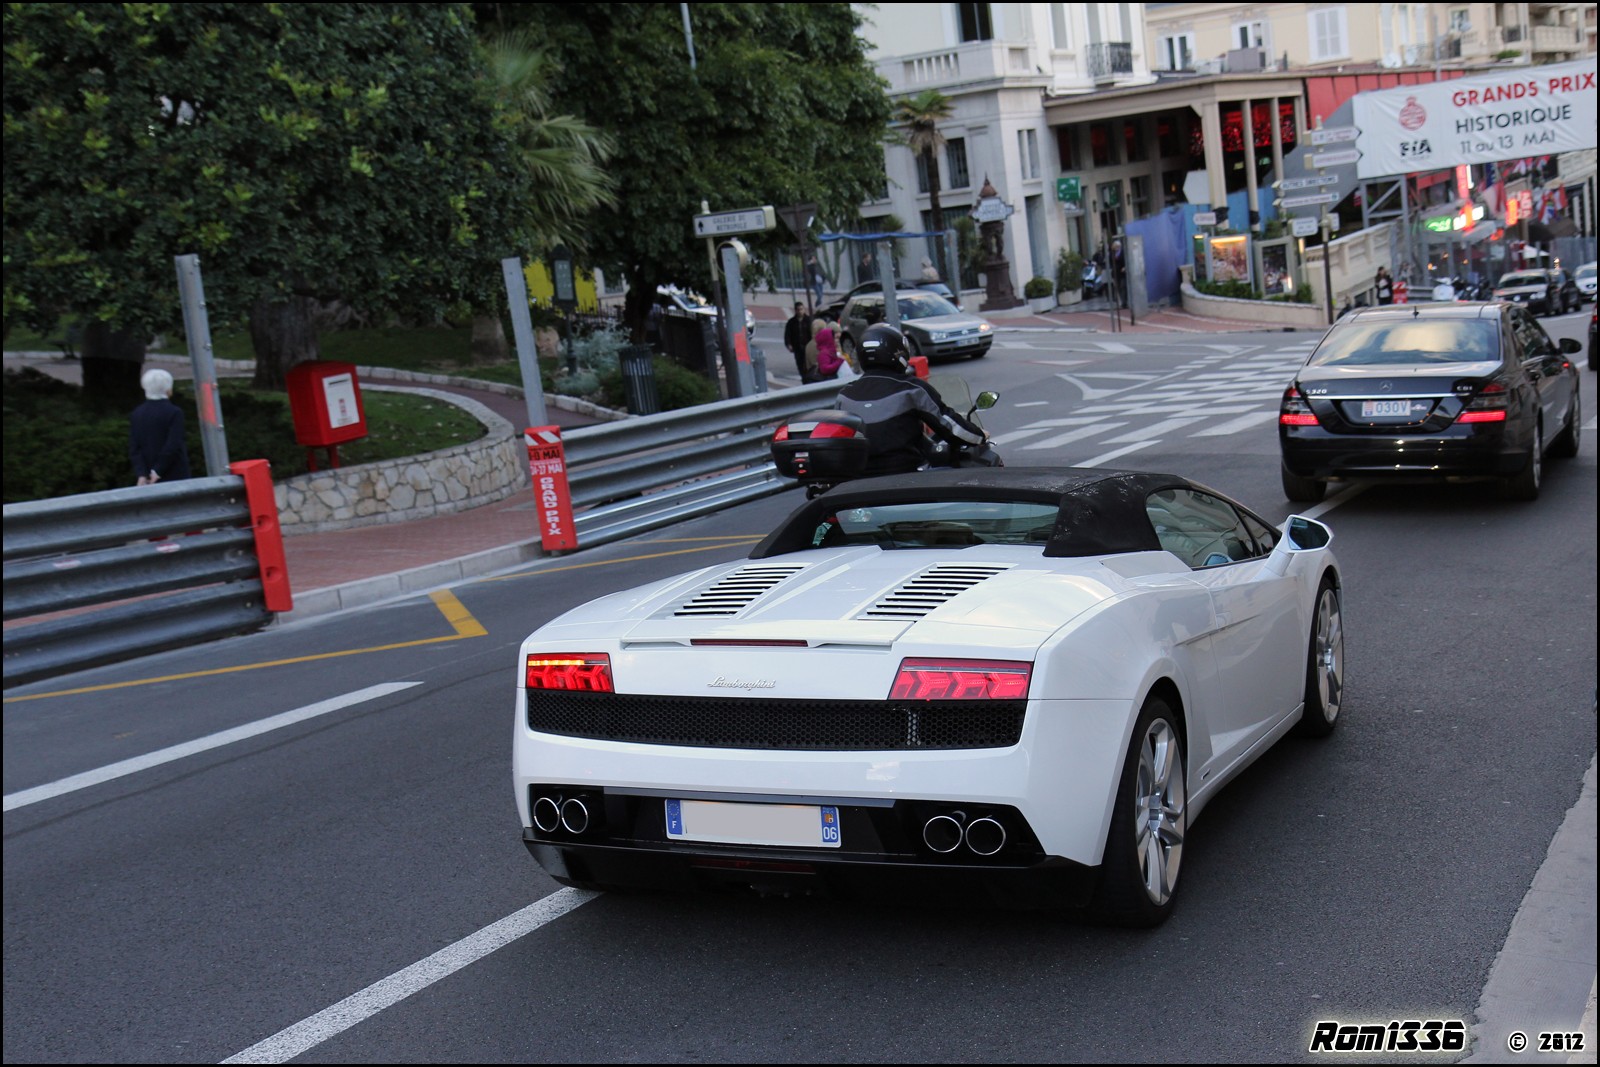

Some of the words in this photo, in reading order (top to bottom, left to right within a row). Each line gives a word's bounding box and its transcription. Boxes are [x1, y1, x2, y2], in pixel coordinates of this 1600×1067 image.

[1452, 83, 1538, 107] GRANDS
[1549, 72, 1597, 94] PRIX
[1456, 105, 1572, 134] HISTORIQUE
[1460, 141, 1471, 154] 11
[1475, 140, 1494, 152] au
[1498, 136, 1514, 149] 13
[1522, 130, 1556, 147] MAI
[1375, 401, 1408, 414] 030V
[543, 449, 560, 459] MAI
[547, 463, 563, 474] MAI
[540, 477, 559, 509] GRAND
[545, 510, 562, 535] PRIX
[707, 675, 777, 691] Lamborghini
[671, 820, 677, 829] F
[822, 826, 838, 840] 06
